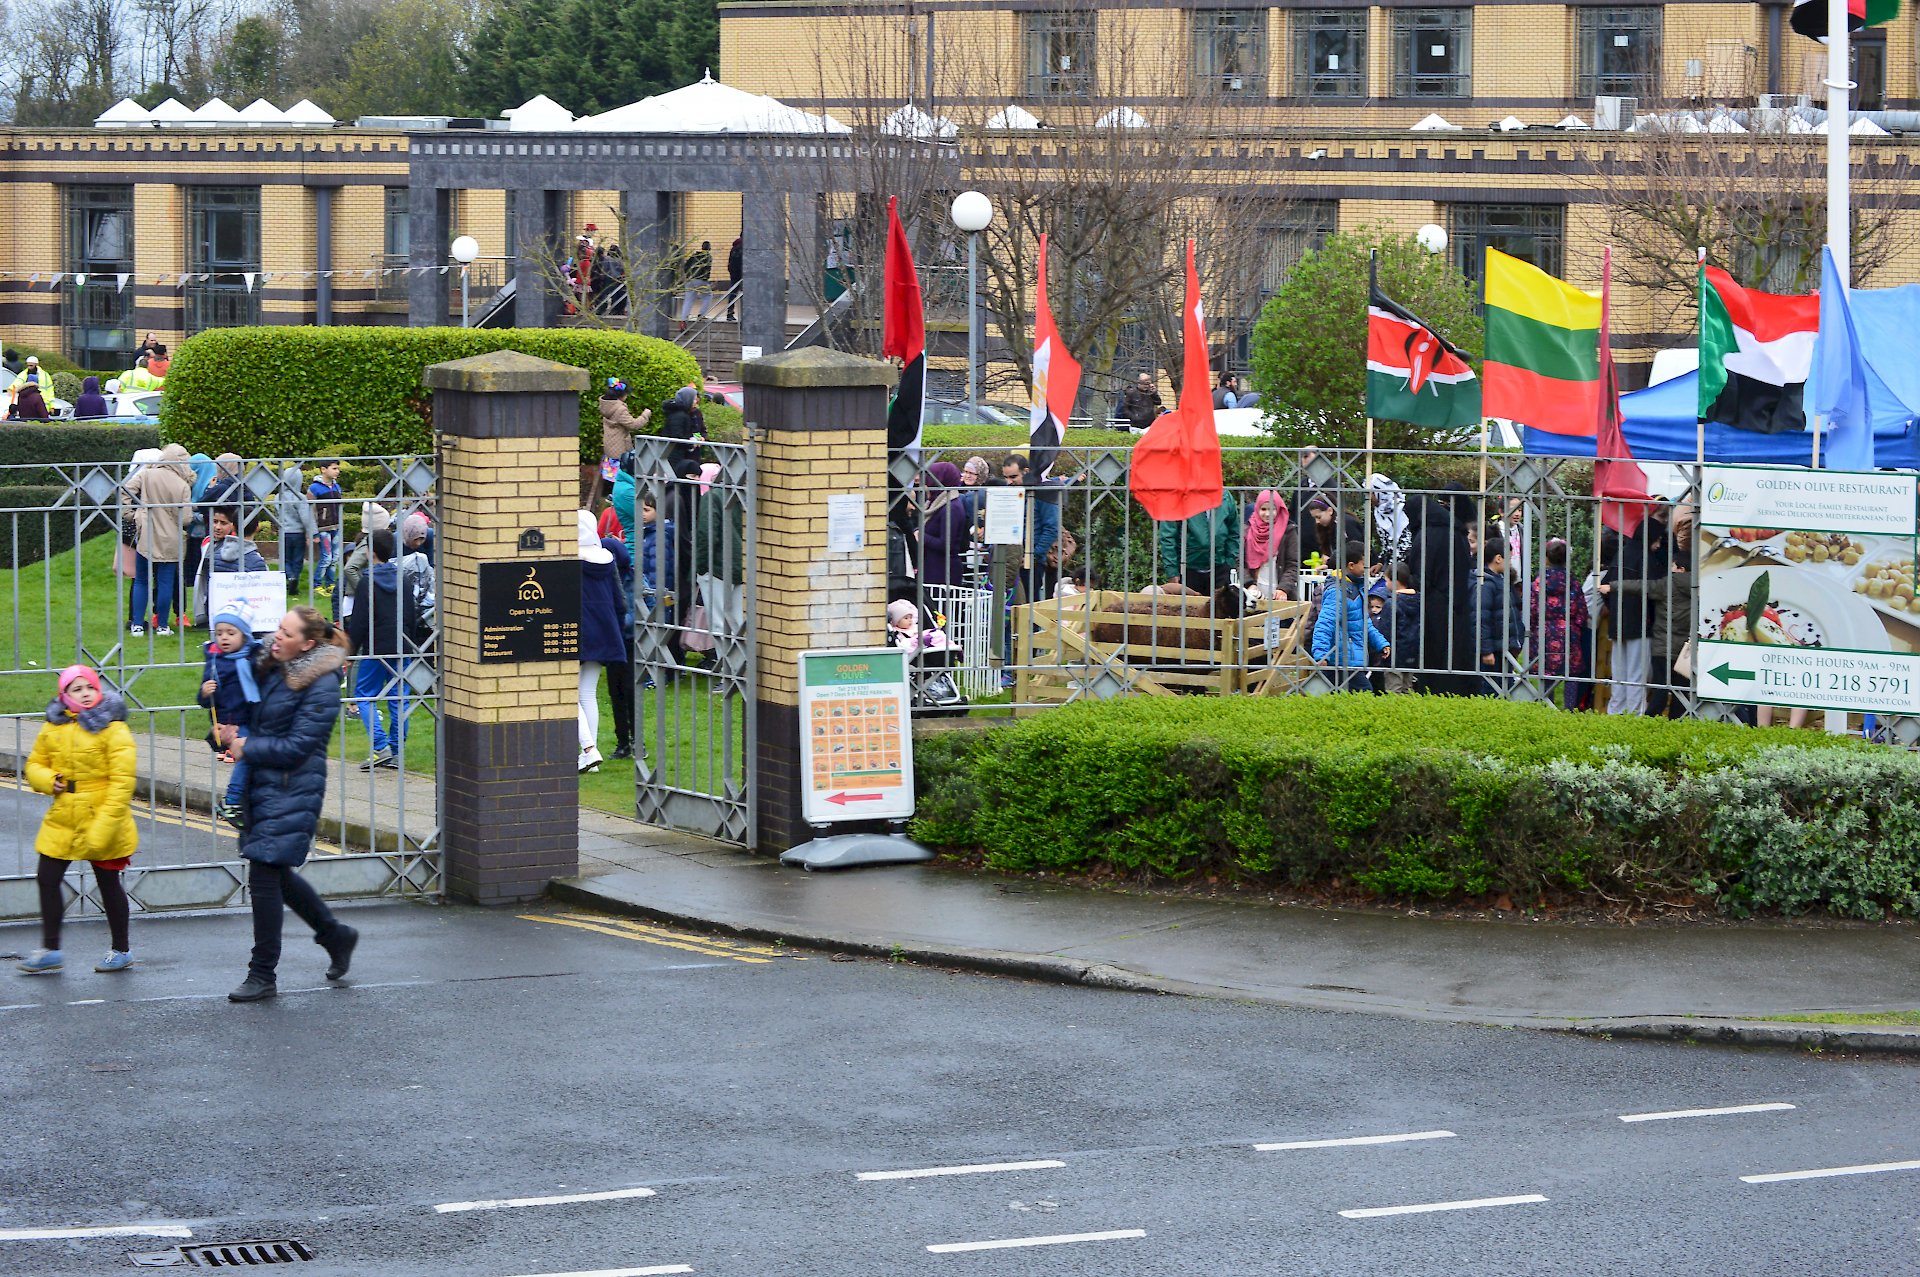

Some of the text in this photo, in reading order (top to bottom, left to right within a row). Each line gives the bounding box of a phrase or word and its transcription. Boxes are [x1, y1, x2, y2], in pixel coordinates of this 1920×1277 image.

[1756, 480, 1910, 496] GOLDEN OLIVE RESTAURANT
[1775, 500, 1889, 513] YOUR LOCAL FAMILY RESTAURANT
[1757, 509, 1908, 523] SERVING DELICIOUS MEDITERRANEAN FOOD
[526, 535, 539, 546] 19
[518, 589, 540, 601] ICC
[509, 608, 525, 617] Open
[1761, 653, 1813, 666] OPENING
[1816, 657, 1855, 669] HOURS
[837, 664, 869, 673] GOLDEN
[841, 671, 865, 679] OLIVE
[1802, 671, 1821, 689] 01
[1829, 673, 1861, 692] 218
[1867, 676, 1909, 694] 5791
